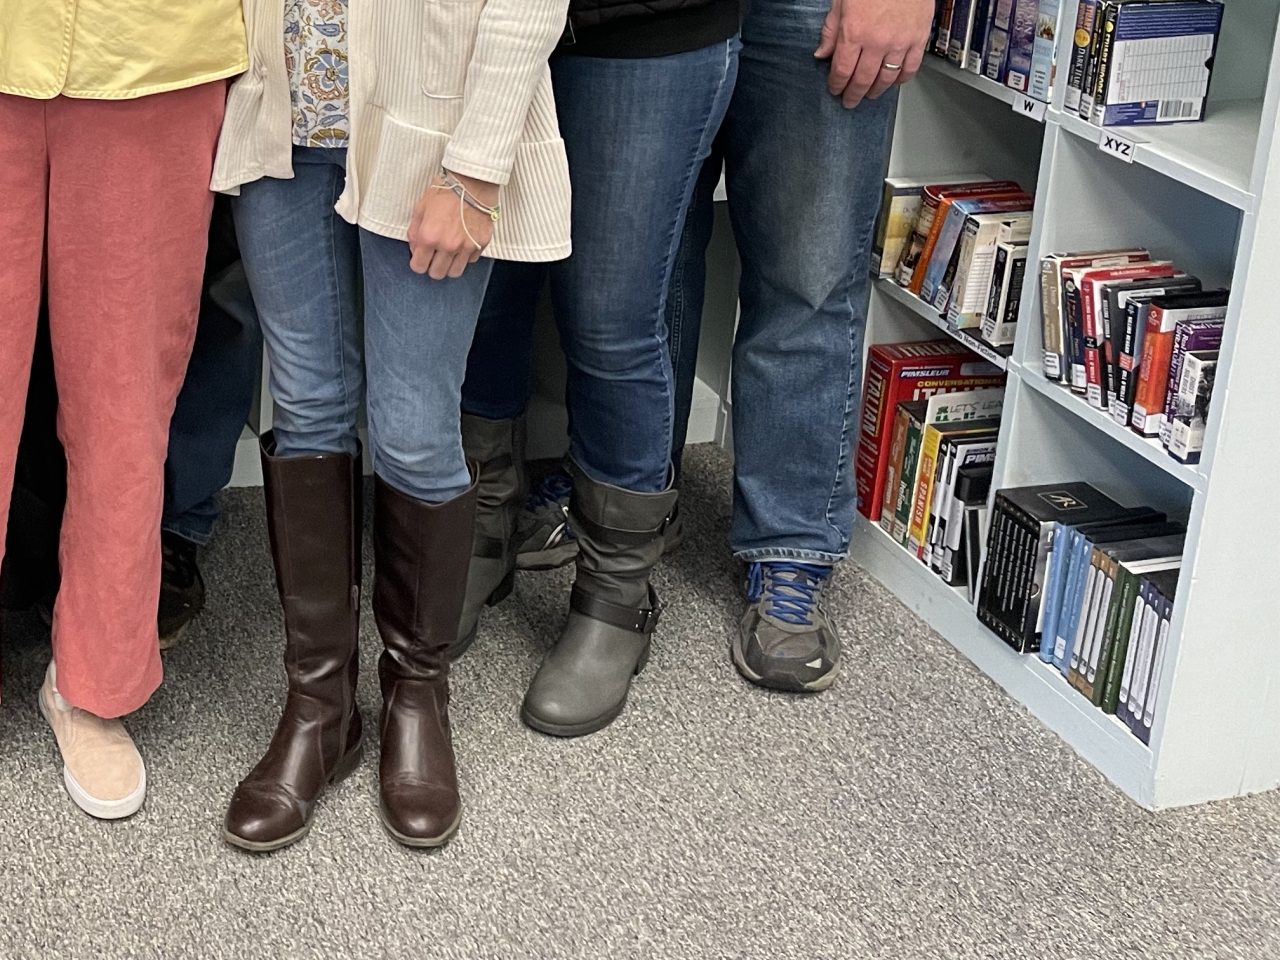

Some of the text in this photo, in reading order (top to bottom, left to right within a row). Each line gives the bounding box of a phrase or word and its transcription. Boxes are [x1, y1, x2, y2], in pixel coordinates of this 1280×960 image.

[1015, 0, 1025, 32] WIGGS
[1024, 0, 1036, 35] SUSAN
[1073, 48, 1086, 89] DARK HAR
[1024, 99, 1035, 113] W
[1104, 136, 1131, 156] XYZ
[963, 332, 997, 361] Non-Fiction
[900, 368, 950, 378] PIMSLEUR
[916, 378, 1003, 388] CONVERSATIONAL
[862, 370, 883, 437] ITALIAN
[950, 399, 1003, 413] LET'S LEA
[965, 453, 995, 465] PIMS
[914, 480, 929, 525] SPANISH
